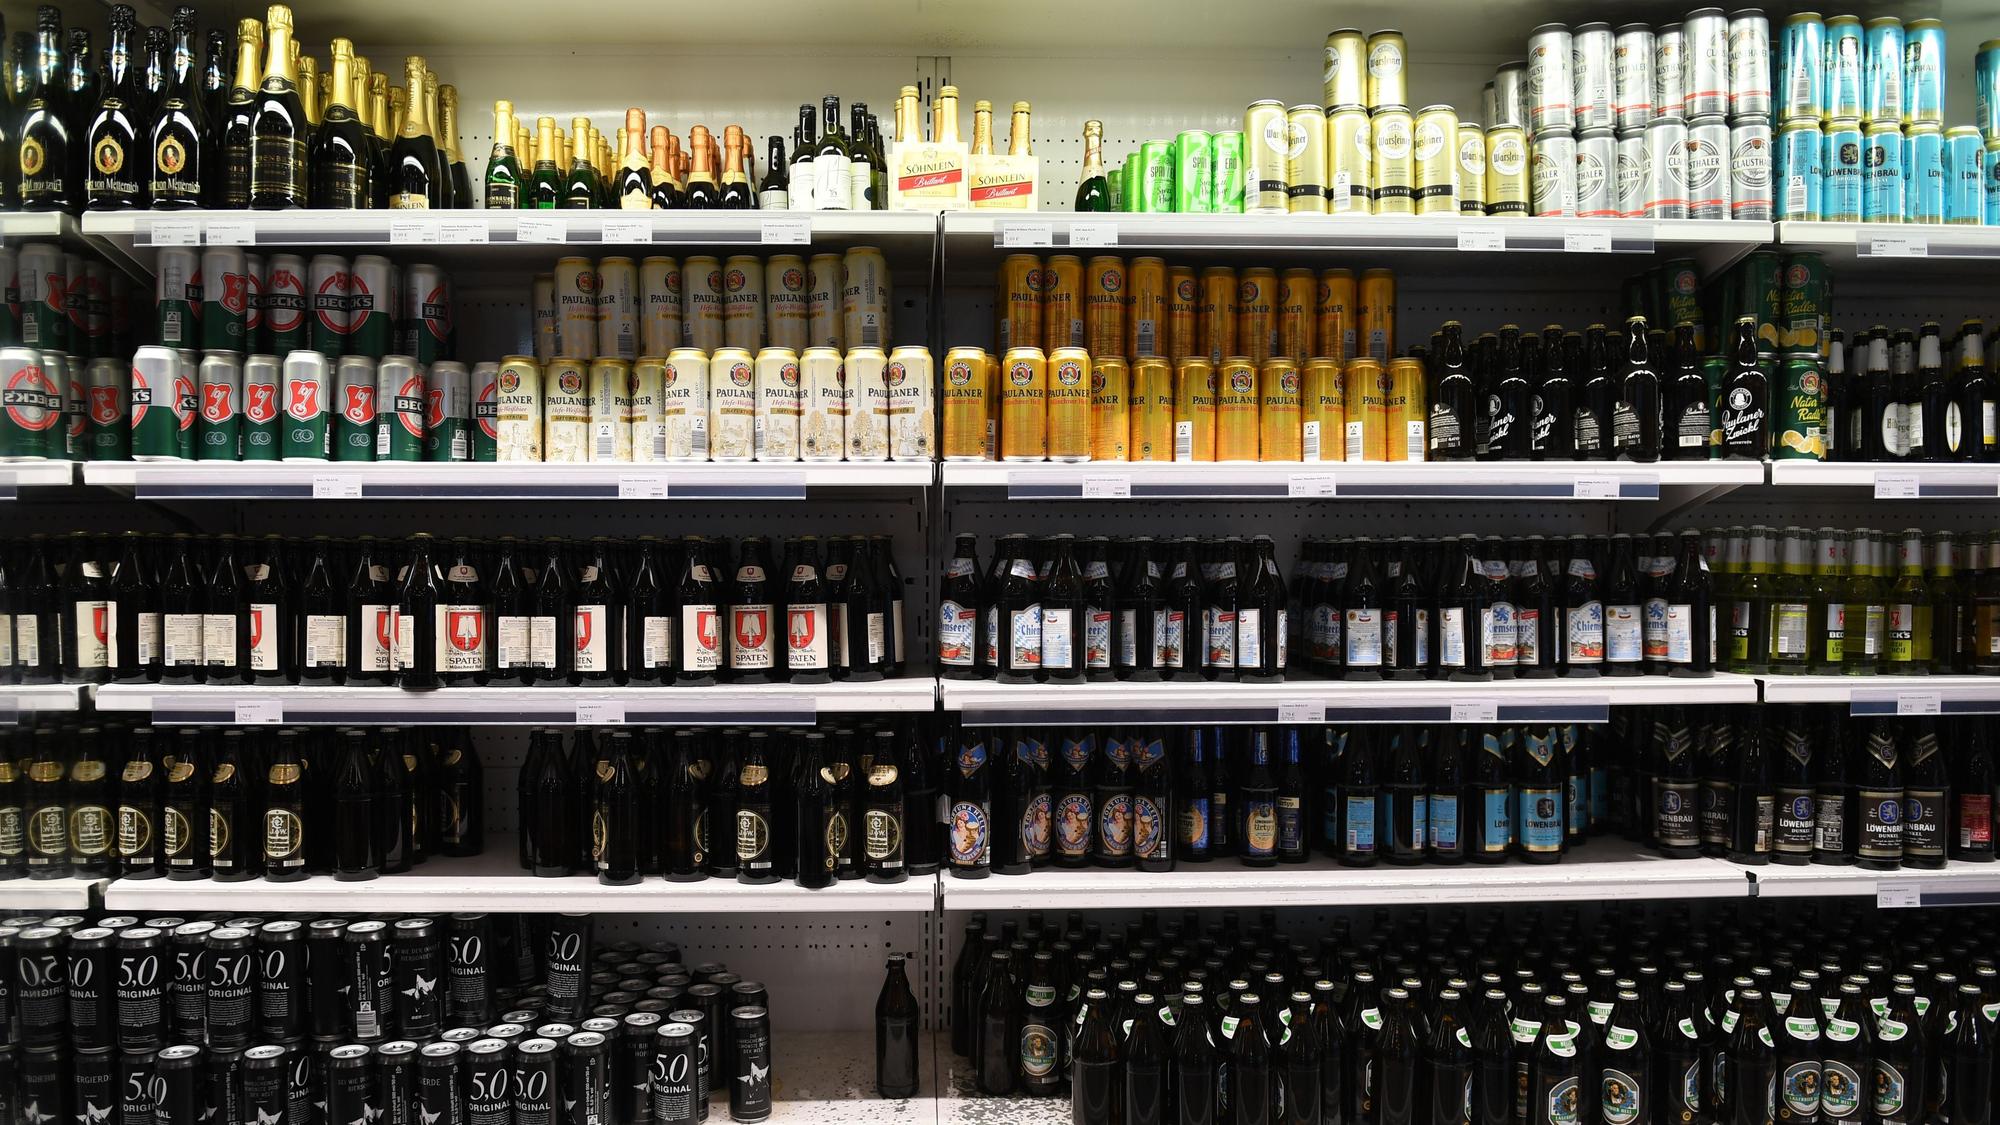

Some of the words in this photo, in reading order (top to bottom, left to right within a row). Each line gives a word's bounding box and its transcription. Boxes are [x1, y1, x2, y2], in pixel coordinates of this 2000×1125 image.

[1369, 56, 1401, 68] Warsteiner
[1378, 133, 1411, 147] Warsteiner
[1415, 135, 1443, 149] arsteiner
[906, 160, 955, 174] SÖHNLEIN
[1690, 159, 1719, 169] STHALER
[1733, 159, 1768, 169] CLAUSTHA
[1534, 169, 1558, 180] THALER
[1578, 169, 1603, 180] THALER
[1825, 168, 1863, 177] LÖWENBR
[1864, 169, 1898, 179] ENBRÄU
[914, 175, 947, 186] Brillant
[978, 173, 1025, 185] SÖHNLEIN
[985, 187, 1017, 198] Brillant
[267, 297, 304, 307] ECK'S
[562, 296, 595, 304] PAULA
[650, 295, 679, 303] PAULA
[693, 294, 721, 303] PAULA
[726, 294, 758, 303] LANER
[770, 294, 808, 303] PAULAN
[1012, 293, 1041, 302] PAULA
[1089, 296, 1126, 304] PAULAN
[666, 389, 690, 398] ANER
[717, 388, 754, 398] PAULANE
[766, 388, 799, 398] PAULAN
[822, 388, 843, 398] PAUL
[868, 388, 889, 397] PAUL
[890, 388, 919, 397] LANER
[945, 389, 983, 398] AULANER
[1048, 388, 1090, 398] PAULANER
[397, 399, 422, 410] BEC
[498, 396, 532, 405] ULANER
[548, 396, 588, 406] PAULANE
[1093, 396, 1118, 404] ANER
[1193, 396, 1215, 404] PAUL
[1218, 395, 1257, 405] PAULANE
[1266, 396, 1300, 405] PAULAN
[1320, 395, 1343, 405] PAUL
[1791, 396, 1817, 409] Natur
[1798, 408, 1820, 420] Radl
[939, 623, 965, 633] emseer
[1021, 624, 1040, 637] Chiem
[1577, 621, 1602, 633] Chiems
[697, 656, 715, 664] SPAT
[735, 654, 768, 662] SPATEN
[1780, 817, 1815, 828] LÖWENBRÄ
[1866, 822, 1903, 833] LÖWENBRÄ
[1905, 822, 1936, 832] ENBRÄU
[450, 936, 481, 965] 5,0
[549, 931, 580, 961] 5,0
[118, 955, 158, 987] 5,0
[211, 954, 251, 988] 5,0
[174, 983, 204, 992] ORIGIN
[263, 982, 290, 990] GINAL
[70, 990, 99, 998] GINAL
[117, 988, 162, 998] ORIGINAL
[208, 988, 252, 997] ORIGINAL
[655, 1053, 688, 1083] 5,0
[470, 1068, 508, 1101] 5,0
[515, 1070, 547, 1101] 5,0
[653, 1085, 691, 1094] ORIGINAL
[123, 1103, 154, 1113] ORIGI
[469, 1100, 511, 1113] ORIGINAL
